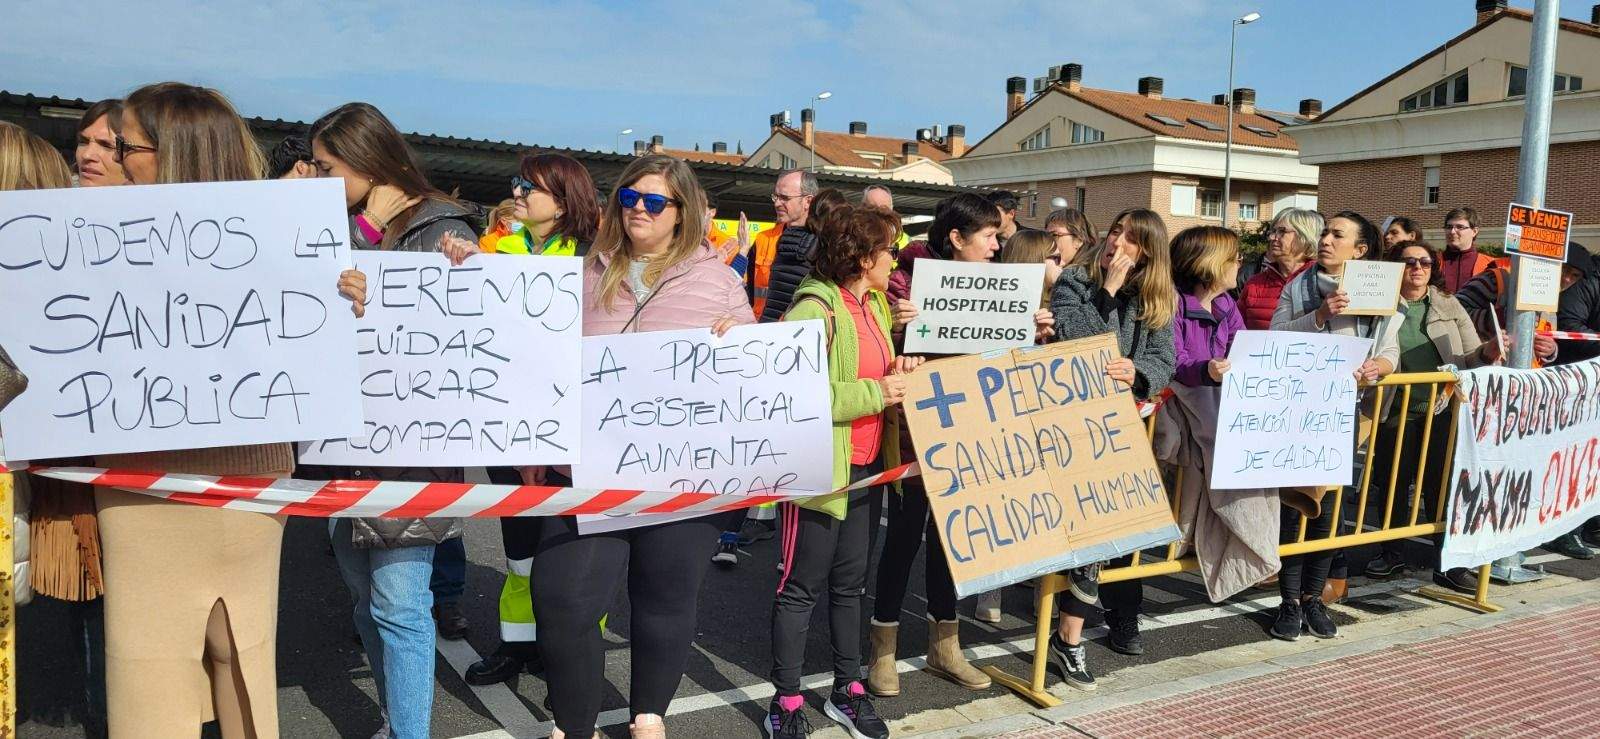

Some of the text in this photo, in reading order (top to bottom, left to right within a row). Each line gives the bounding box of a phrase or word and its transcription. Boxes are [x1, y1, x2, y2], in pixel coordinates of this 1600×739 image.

[1511, 207, 1568, 230] SE VENDE
[0, 211, 344, 271] CUIDEMOS LA
[941, 275, 1019, 291] MEJORES
[30, 288, 328, 354] SANIDAD
[922, 298, 1029, 313] HOSPITALES
[916, 324, 1028, 341] + RECURSOS
[653, 327, 821, 385] PRESIÓN
[1249, 338, 1346, 373] HUESCA
[53, 367, 310, 433] PÚBLICA
[360, 367, 510, 403] CURAR
[915, 348, 1130, 428] + PERSONAL
[1226, 371, 1354, 402] NECESITA UNA
[599, 386, 820, 430] ASISTENCIAL
[1229, 406, 1354, 439] ATENCIÓN URGENTE
[616, 436, 787, 474] AUMENTA
[925, 411, 1131, 497] SANIDAD DE
[1233, 444, 1343, 474] DE CALIDAD
[1073, 467, 1168, 521] HUMANA
